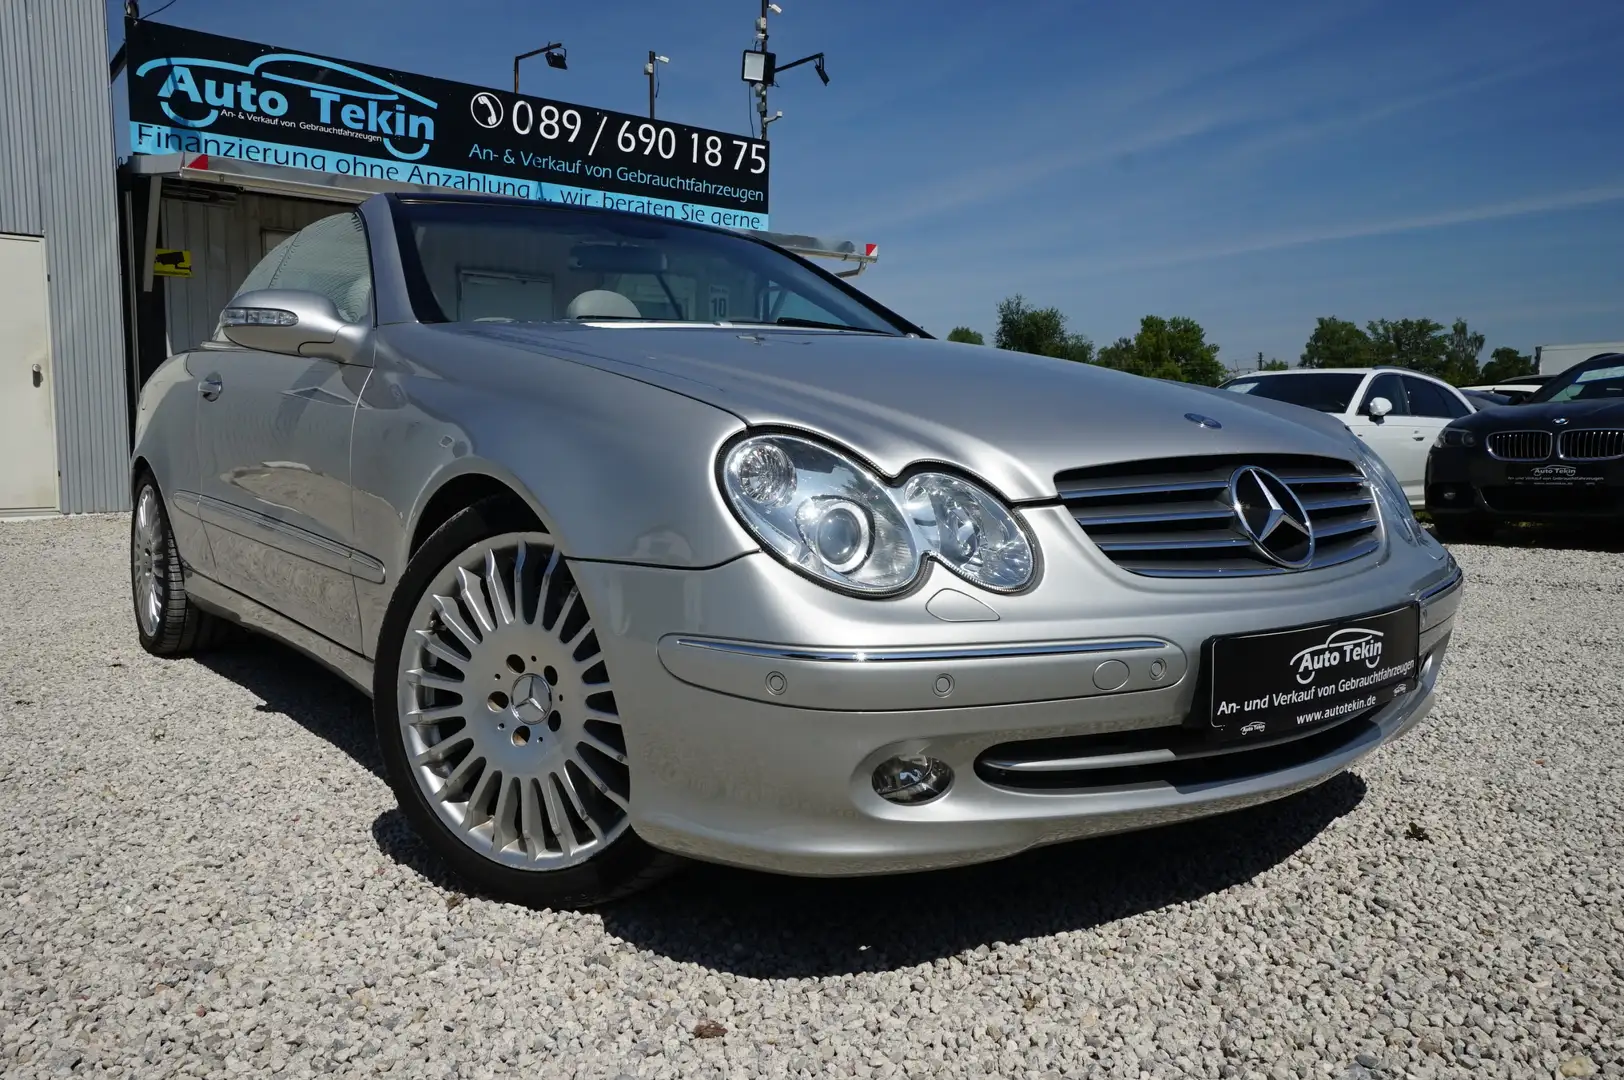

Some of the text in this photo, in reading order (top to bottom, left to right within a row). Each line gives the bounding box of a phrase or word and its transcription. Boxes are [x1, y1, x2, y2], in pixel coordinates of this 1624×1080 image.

[157, 66, 435, 141] Auto Tekin
[220, 109, 382, 143] An- & Verkauf von Gebrauchtfahrzeugen
[512, 100, 766, 174] 089 / 690 18 75
[138, 124, 326, 172] Finanzierung
[335, 157, 399, 182] ohne
[407, 165, 530, 199] Anzahlung
[559, 188, 592, 205] wir
[602, 192, 675, 219] beraten
[681, 203, 705, 223] Sie
[468, 143, 764, 203] An- & Verkauf von Gebrauchtfahrzeugen
[1298, 640, 1383, 673] Auto Tekin
[1216, 700, 1241, 716] An-
[1244, 695, 1269, 711] und
[1272, 687, 1315, 706] Verkauf
[1317, 684, 1336, 698] von
[1338, 659, 1415, 693] Gebrauchtfahrzeugen
[1296, 695, 1377, 725] www.autotekin.de
